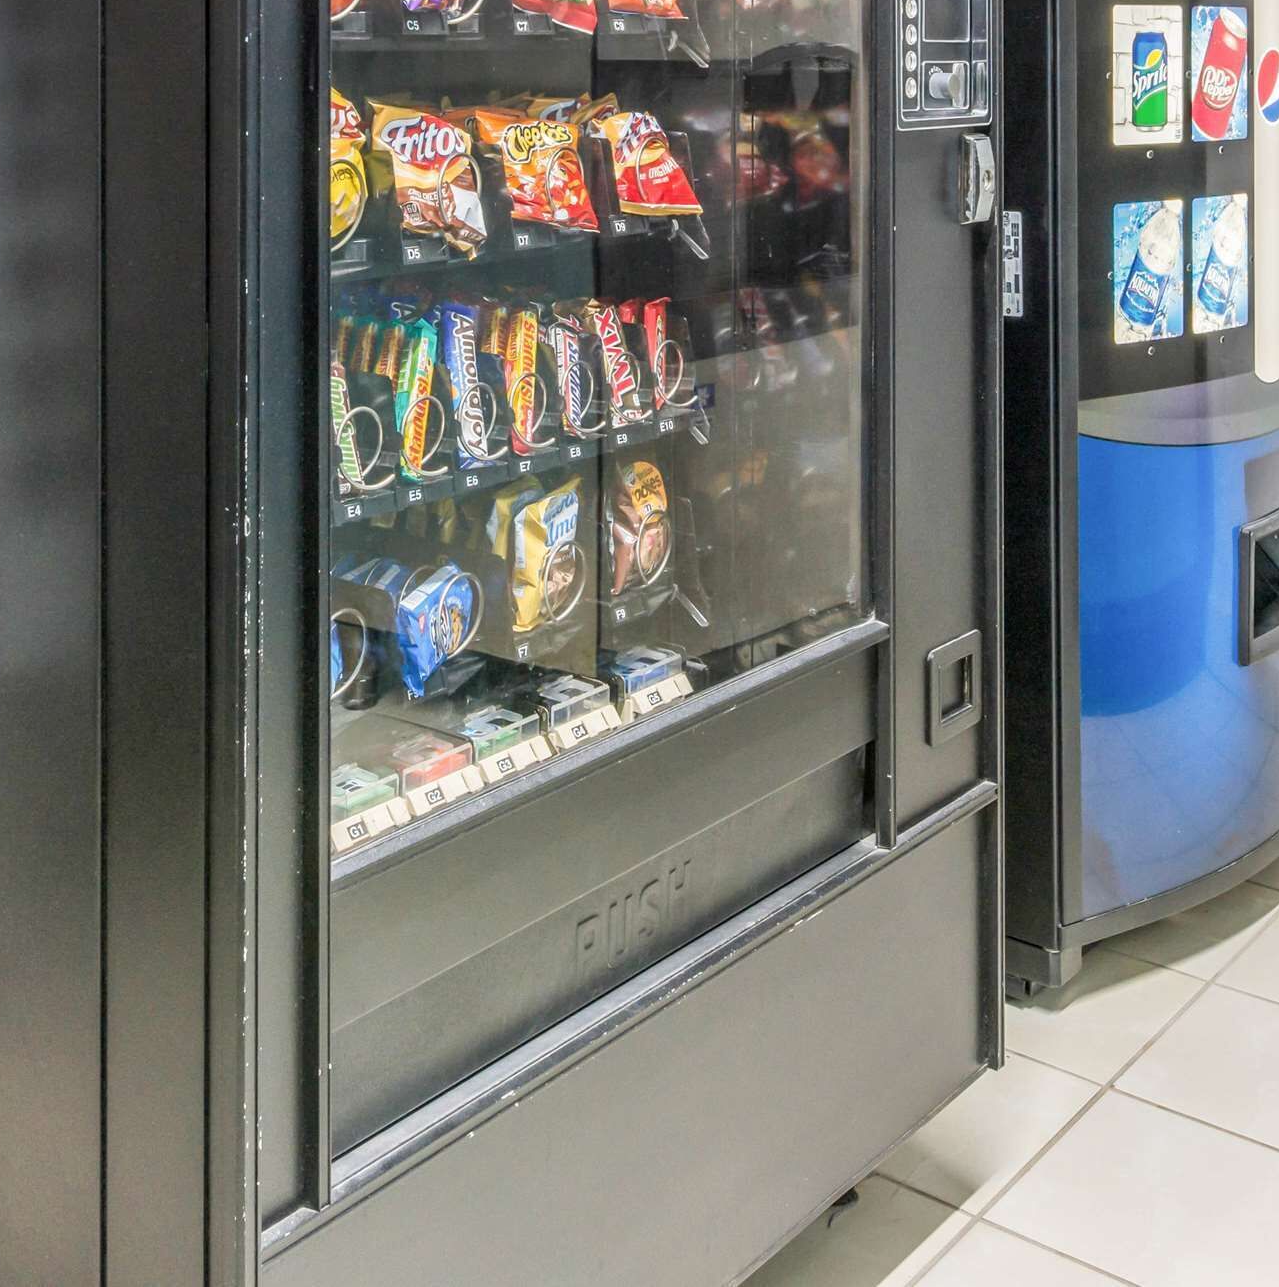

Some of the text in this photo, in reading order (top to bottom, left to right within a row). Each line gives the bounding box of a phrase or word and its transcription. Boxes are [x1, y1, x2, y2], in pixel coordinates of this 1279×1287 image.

[406, 19, 420, 32] C5
[380, 116, 468, 163] Fritos
[504, 122, 573, 162] Cheetos
[407, 247, 421, 260] D5
[595, 308, 634, 407] TWIX
[660, 420, 674, 432] E10
[617, 434, 628, 444] E9
[570, 448, 582, 458] E8
[520, 461, 531, 472] E7
[466, 475, 479, 487] E6
[408, 490, 422, 502] E5
[347, 505, 362, 519] E4
[517, 644, 529, 658] F7
[647, 692, 661, 705] G5
[571, 725, 587, 739] G4
[497, 758, 513, 772] G3
[426, 788, 443, 804] G2
[348, 823, 366, 839] G1
